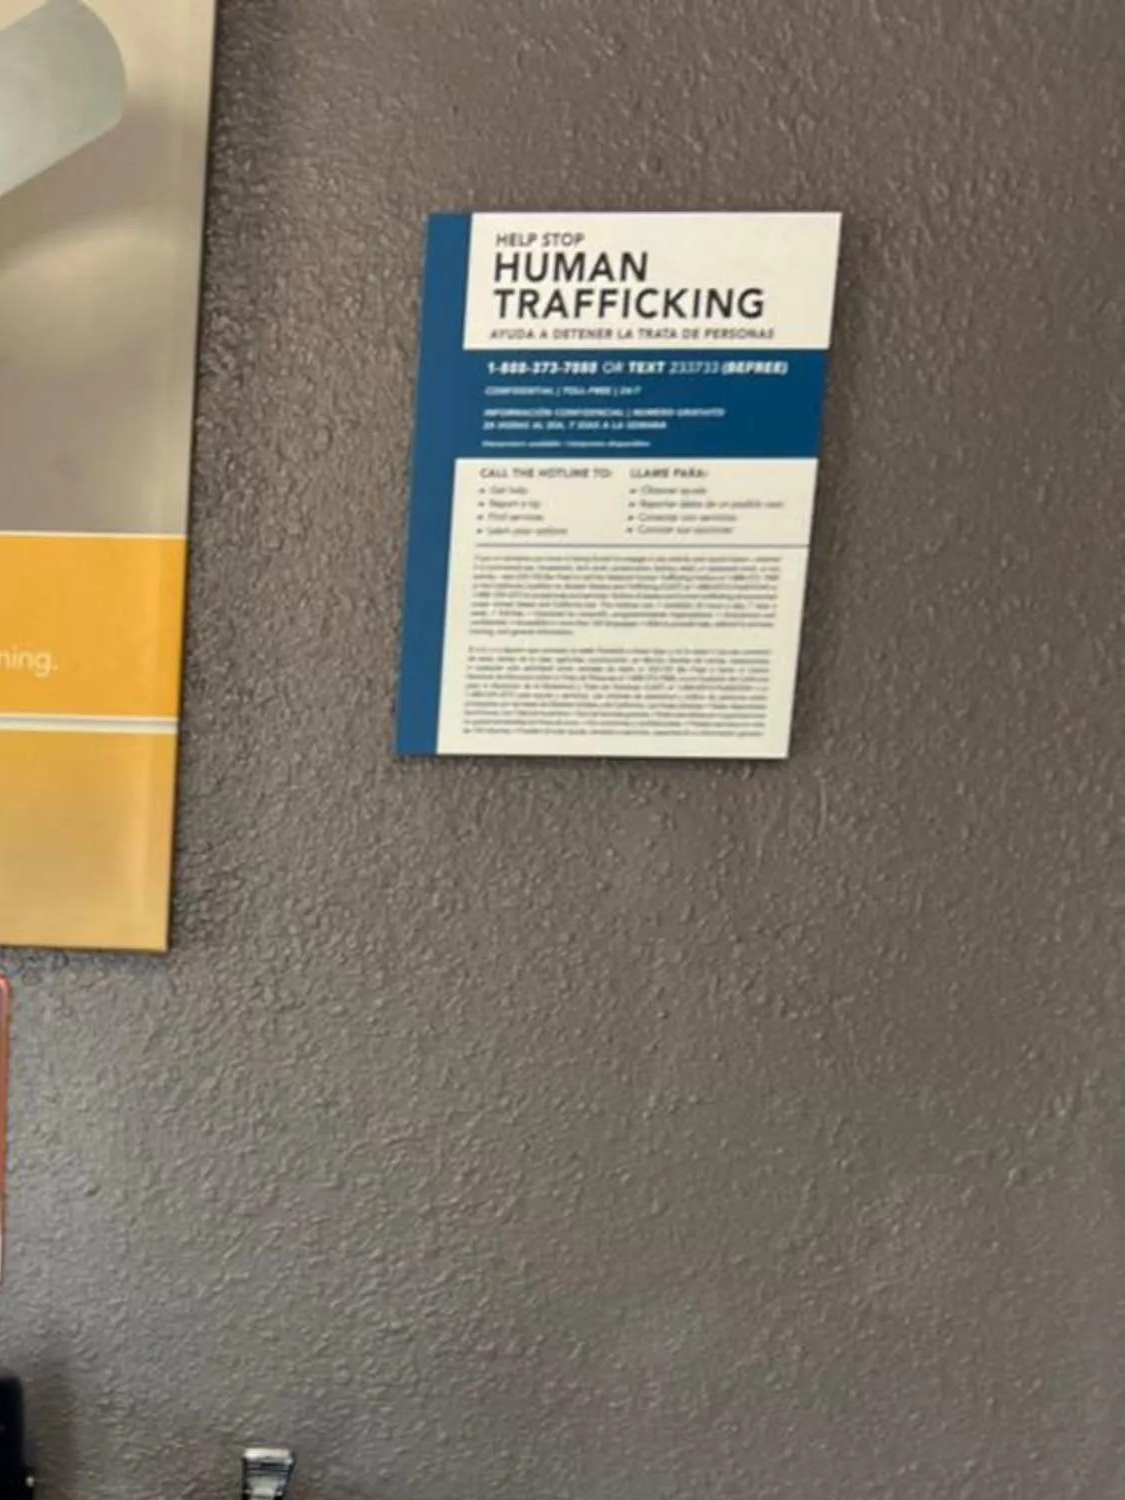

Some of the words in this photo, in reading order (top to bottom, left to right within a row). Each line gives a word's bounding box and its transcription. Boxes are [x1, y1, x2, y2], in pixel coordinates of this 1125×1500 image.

[495, 232, 537, 247] HELP
[542, 232, 585, 247] STOP
[494, 251, 648, 282] HUMAN
[493, 287, 764, 319] TRAFFICKING
[490, 328, 534, 340] AYUDA
[539, 328, 549, 340] A
[553, 328, 613, 340] DETENER
[617, 328, 633, 340] LA
[637, 328, 677, 340] TRATA
[682, 328, 700, 340] DE
[704, 328, 775, 340] PERSONAS
[602, 361, 623, 374] OR
[628, 361, 667, 374] TEXT
